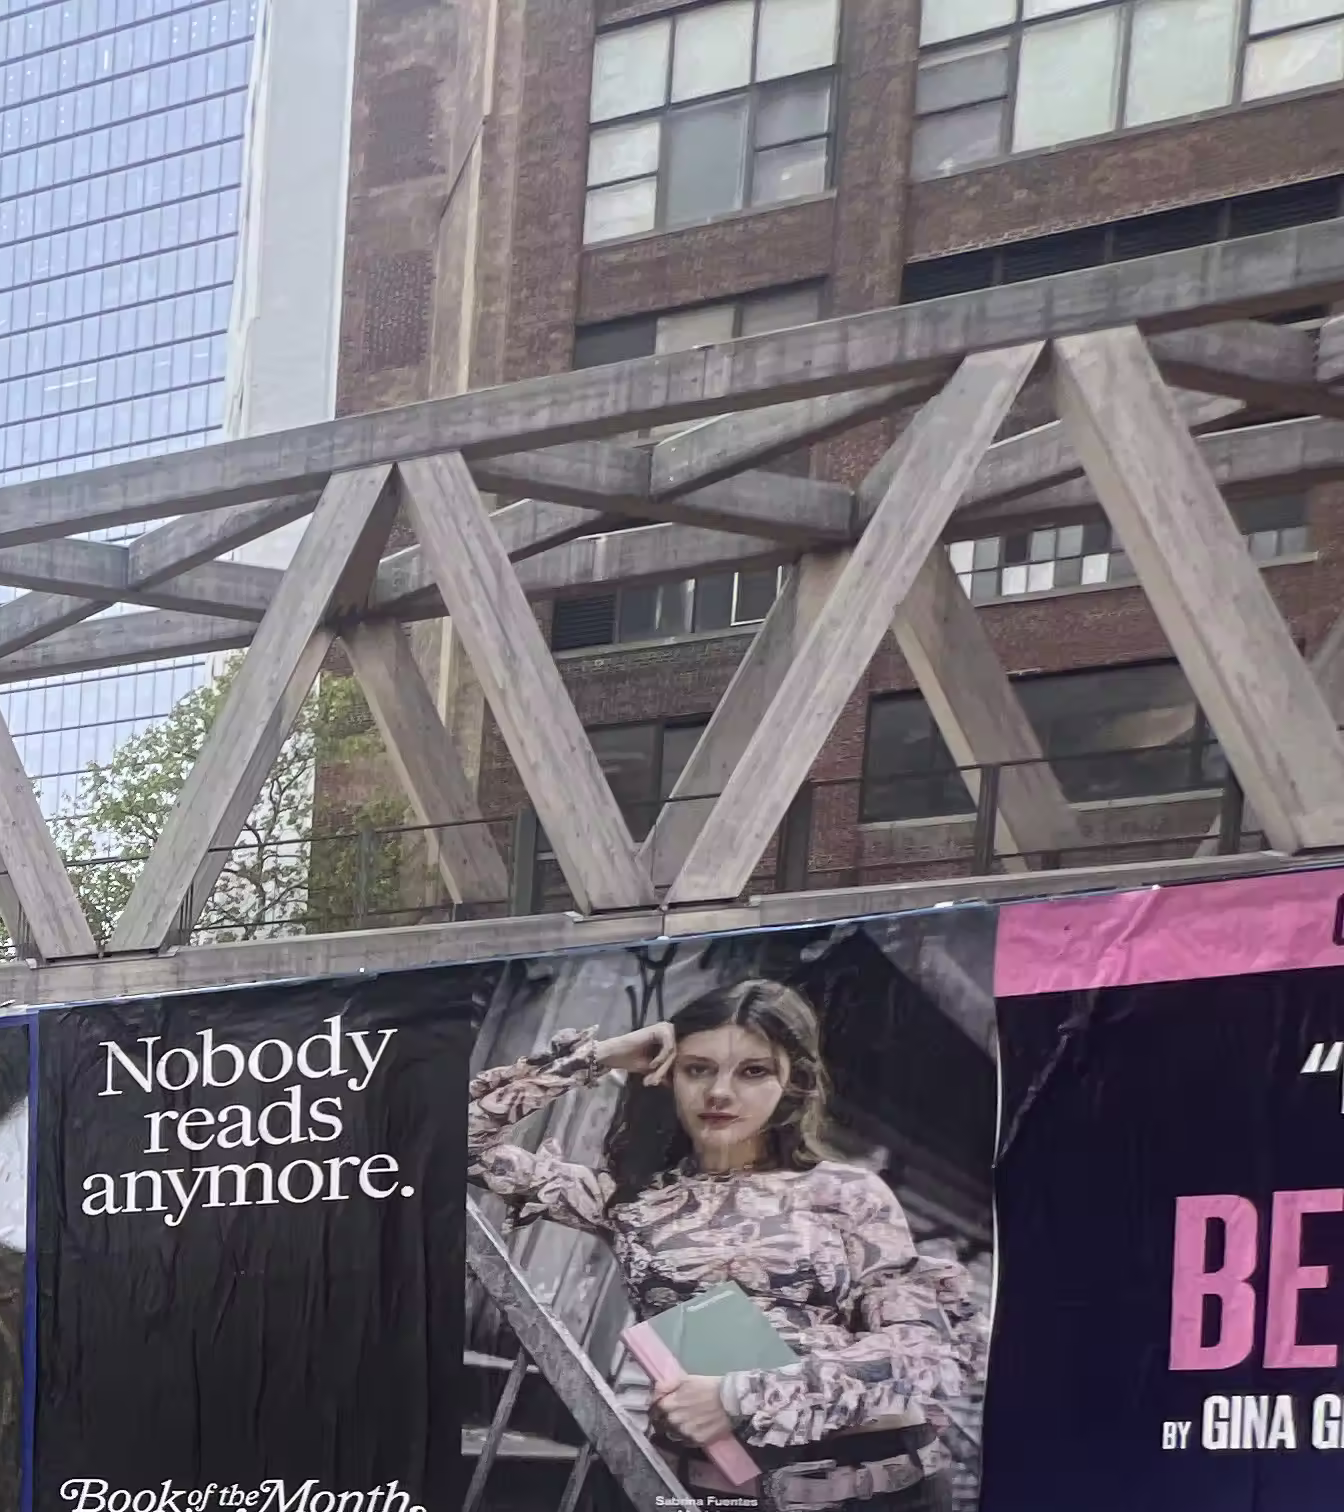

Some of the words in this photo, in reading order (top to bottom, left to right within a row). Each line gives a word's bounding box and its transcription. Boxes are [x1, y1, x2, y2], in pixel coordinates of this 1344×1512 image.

[98, 1015, 399, 1096] Nobody
[143, 1084, 343, 1154] reads
[81, 1151, 415, 1227] anymore.
[1162, 1421, 1192, 1450] BY
[1201, 1394, 1297, 1450] GINA
[186, 1482, 218, 1512] of
[219, 1484, 260, 1508] the
[707, 1496, 759, 1507] Fuentes
